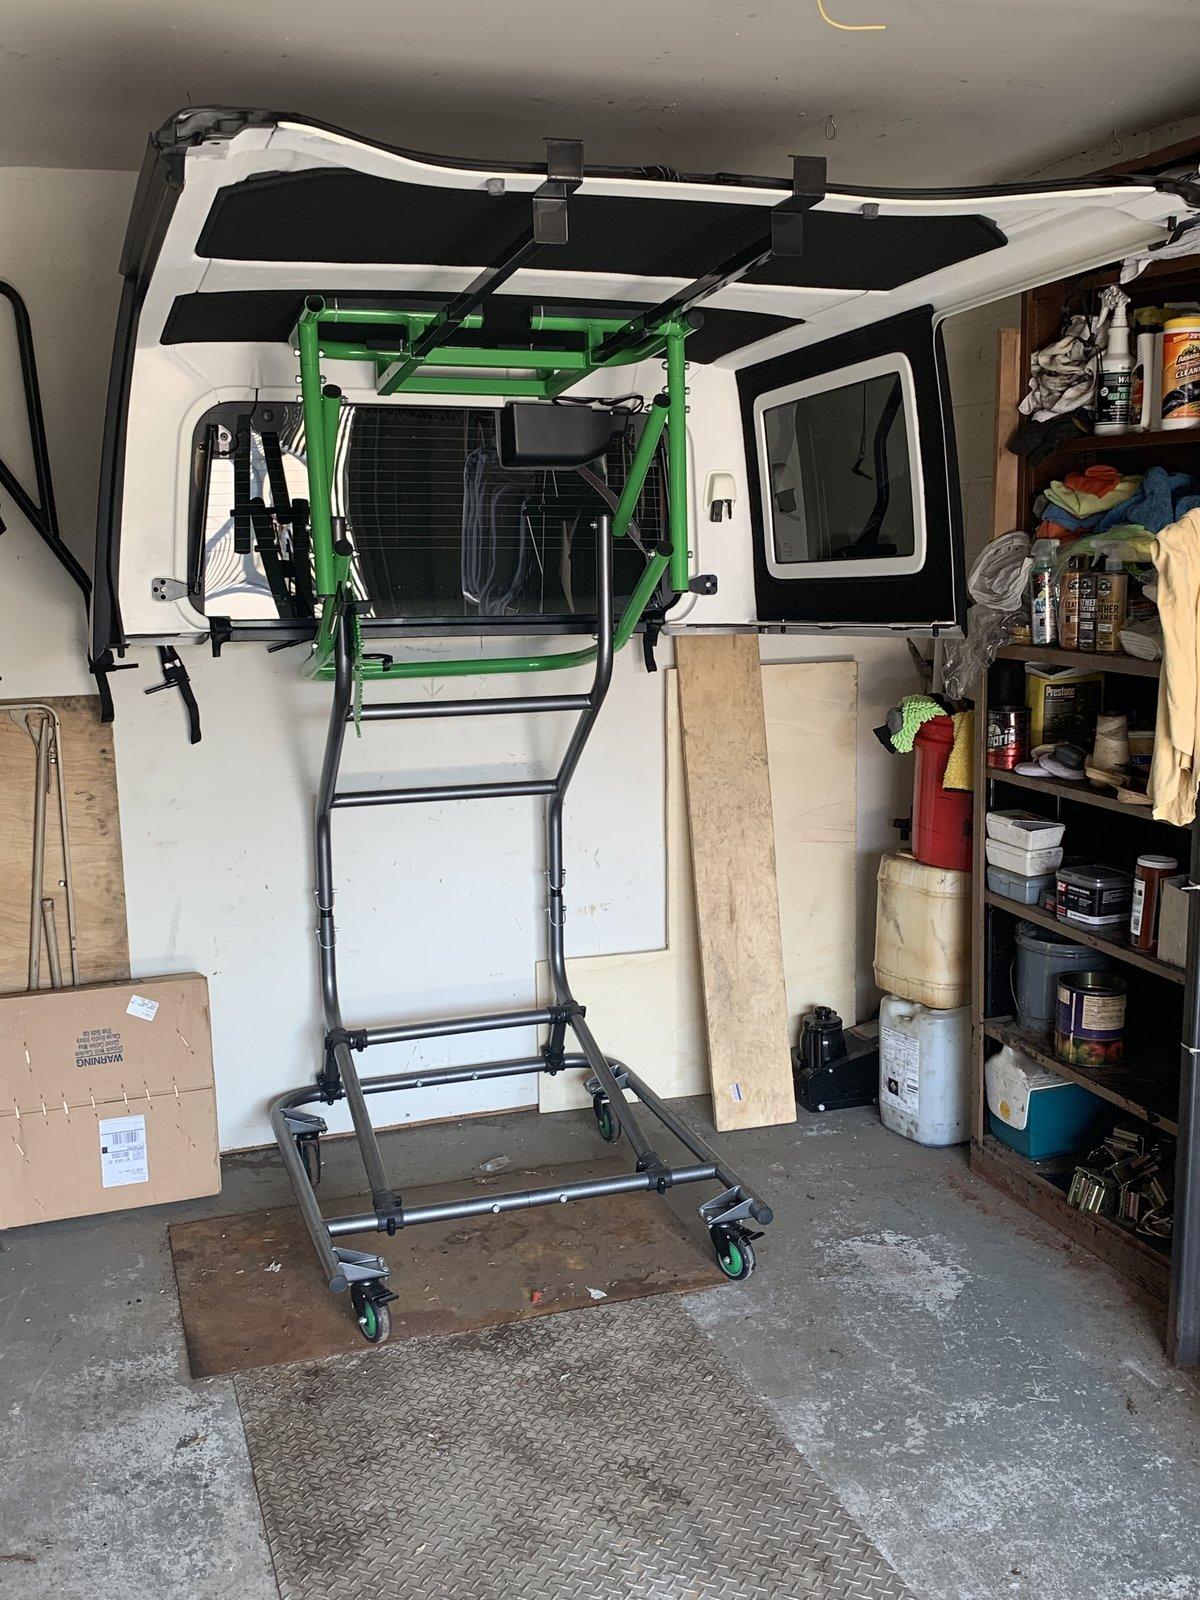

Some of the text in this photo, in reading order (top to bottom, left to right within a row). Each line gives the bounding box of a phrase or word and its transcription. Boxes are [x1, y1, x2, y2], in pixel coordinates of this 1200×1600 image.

[1098, 604, 1119, 613] THER
[1045, 686, 1075, 697] Prestone
[987, 730, 1016, 748] varin
[76, 1053, 123, 1067] WARNING
